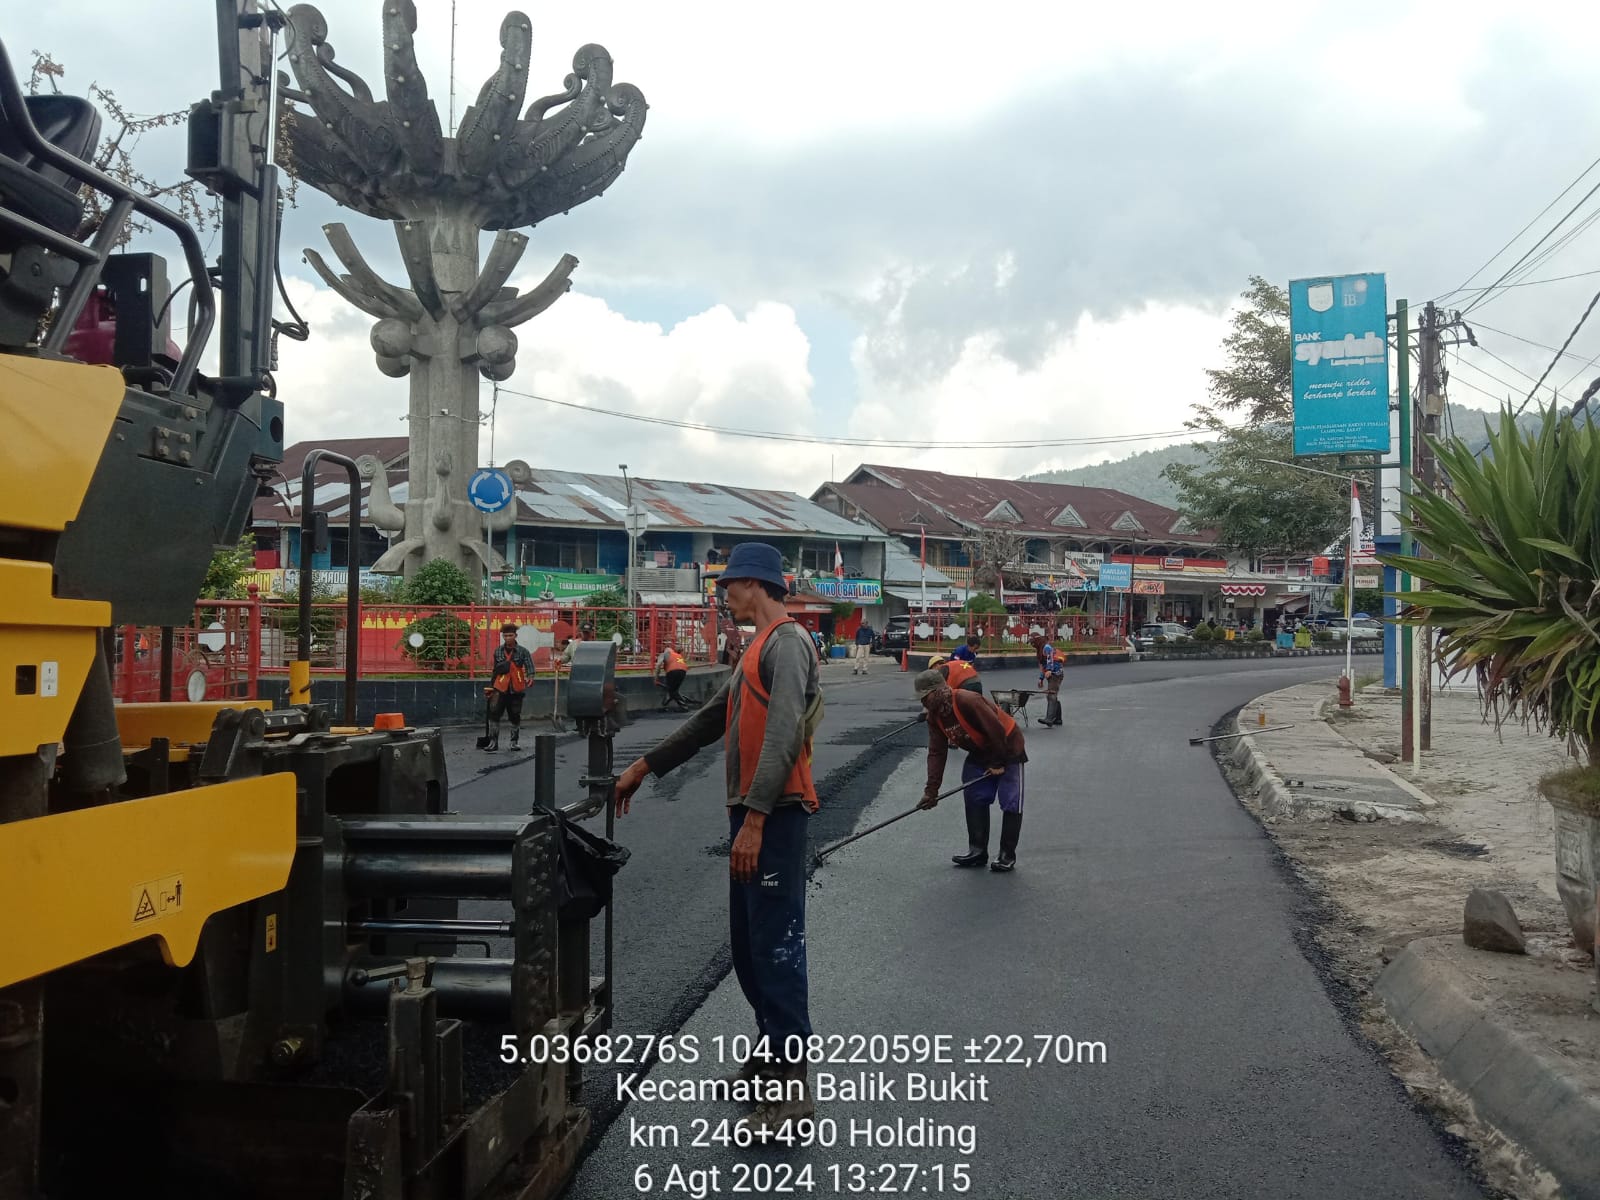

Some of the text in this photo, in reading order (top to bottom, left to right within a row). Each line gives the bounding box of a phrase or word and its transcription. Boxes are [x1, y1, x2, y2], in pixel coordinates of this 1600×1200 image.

[1294, 332, 1322, 342] BANK
[816, 582, 880, 598] TOKO OBAT LARIS
